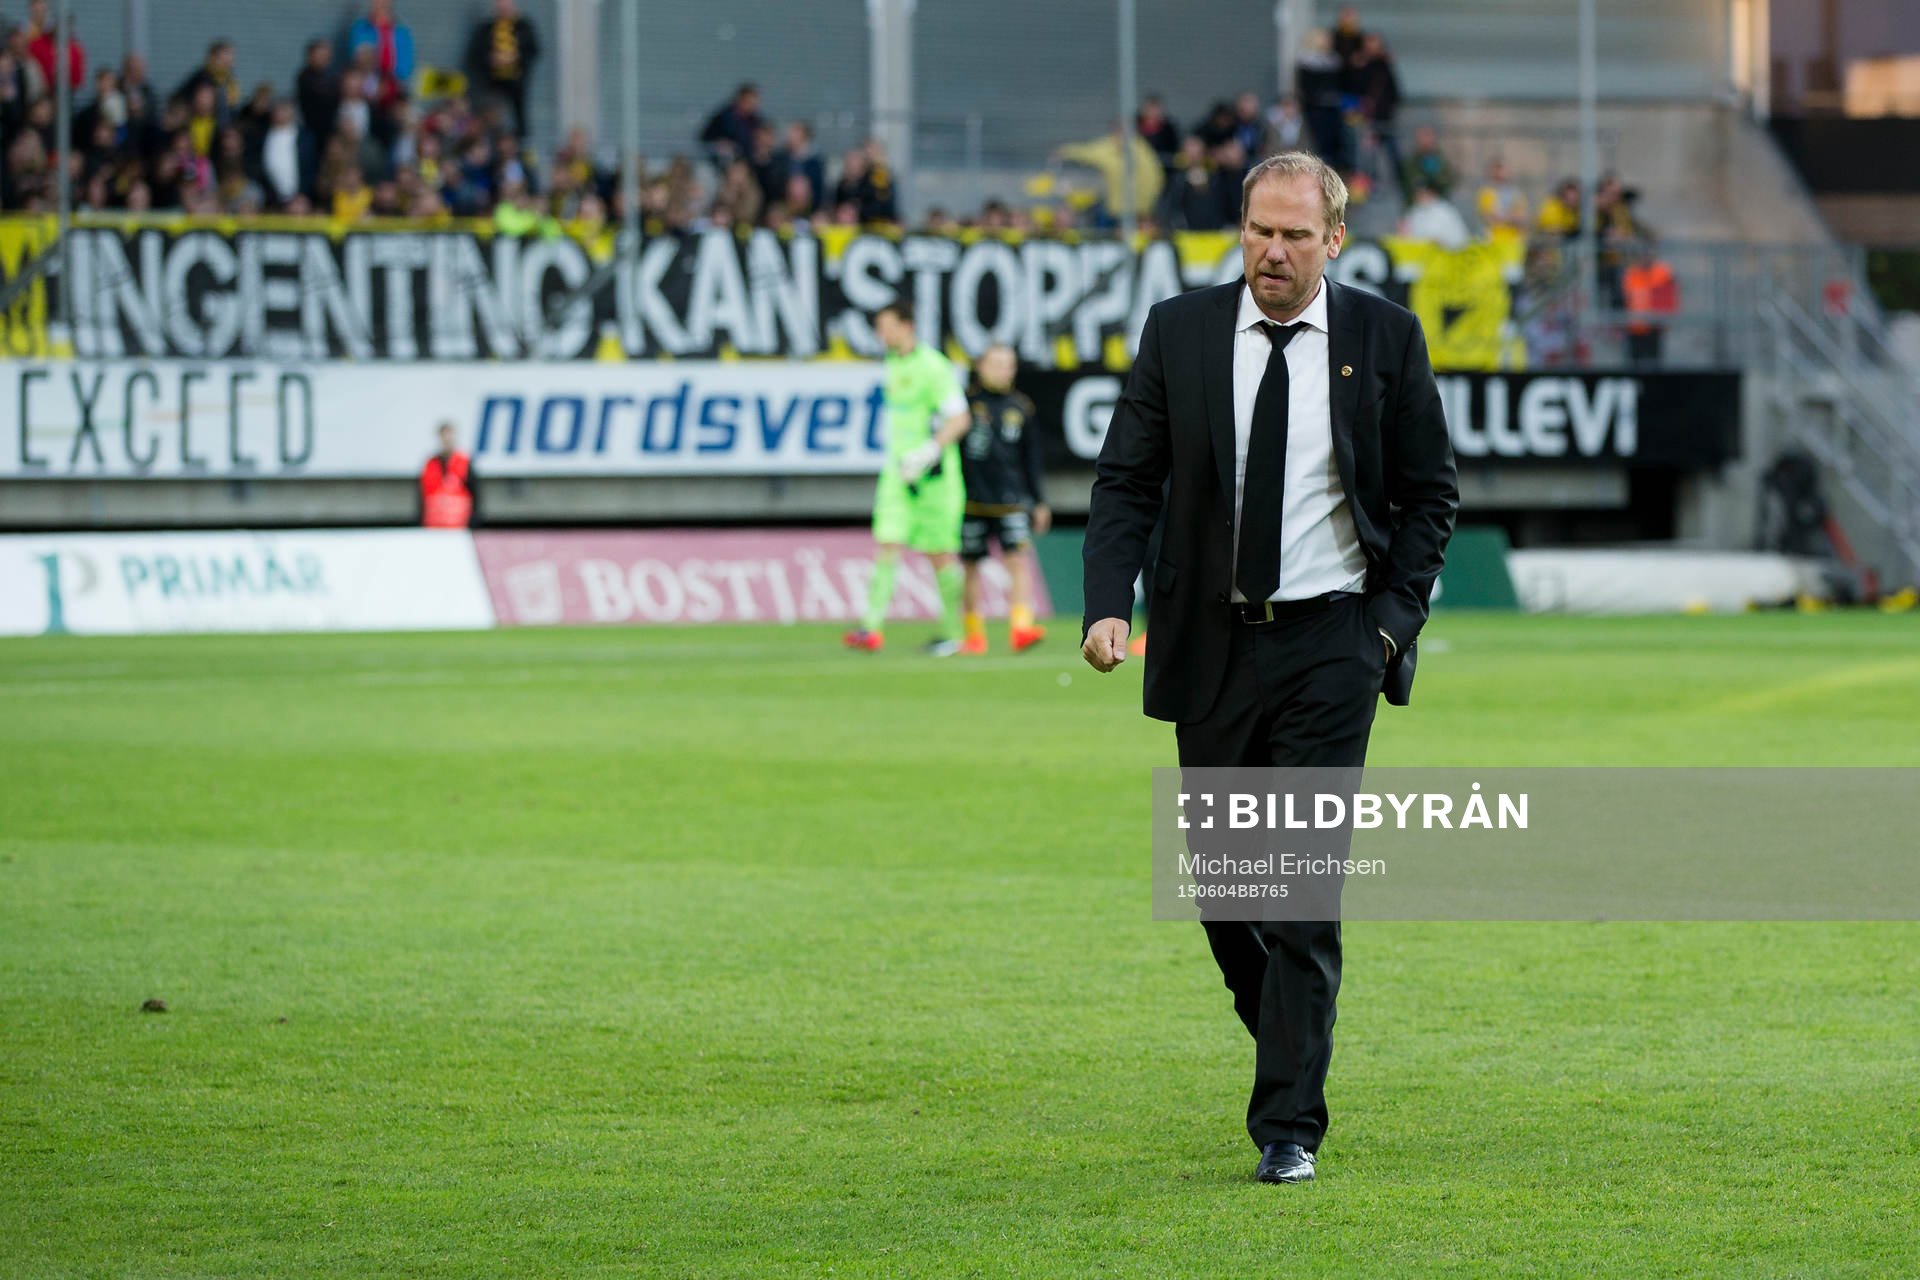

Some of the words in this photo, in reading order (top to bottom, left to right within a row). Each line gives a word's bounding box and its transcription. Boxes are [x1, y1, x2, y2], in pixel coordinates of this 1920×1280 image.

[615, 233, 819, 356] KAN
[19, 370, 315, 466] EXCEED
[1438, 377, 1638, 457] LLEVI
